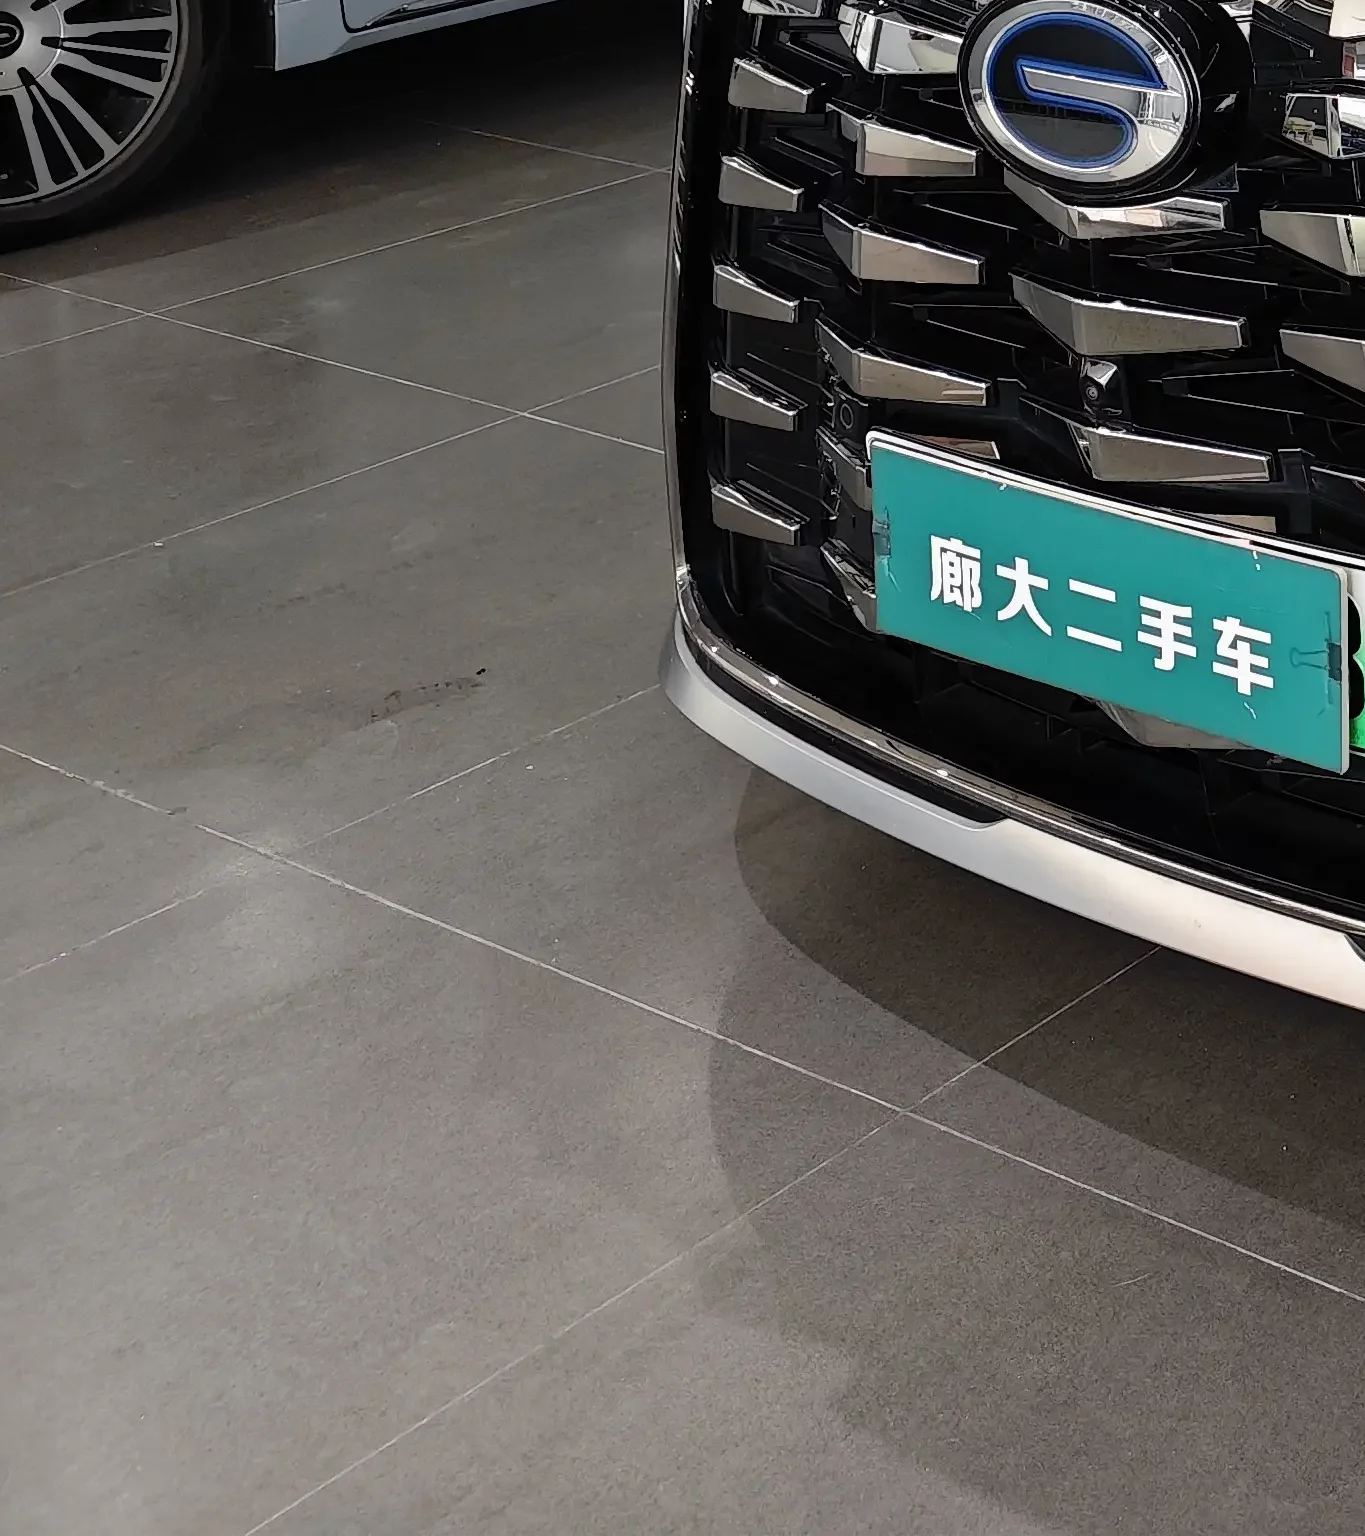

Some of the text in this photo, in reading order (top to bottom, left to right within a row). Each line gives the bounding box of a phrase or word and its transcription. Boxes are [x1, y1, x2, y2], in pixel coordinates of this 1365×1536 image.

[929, 535, 1274, 696] 廊大二手车
